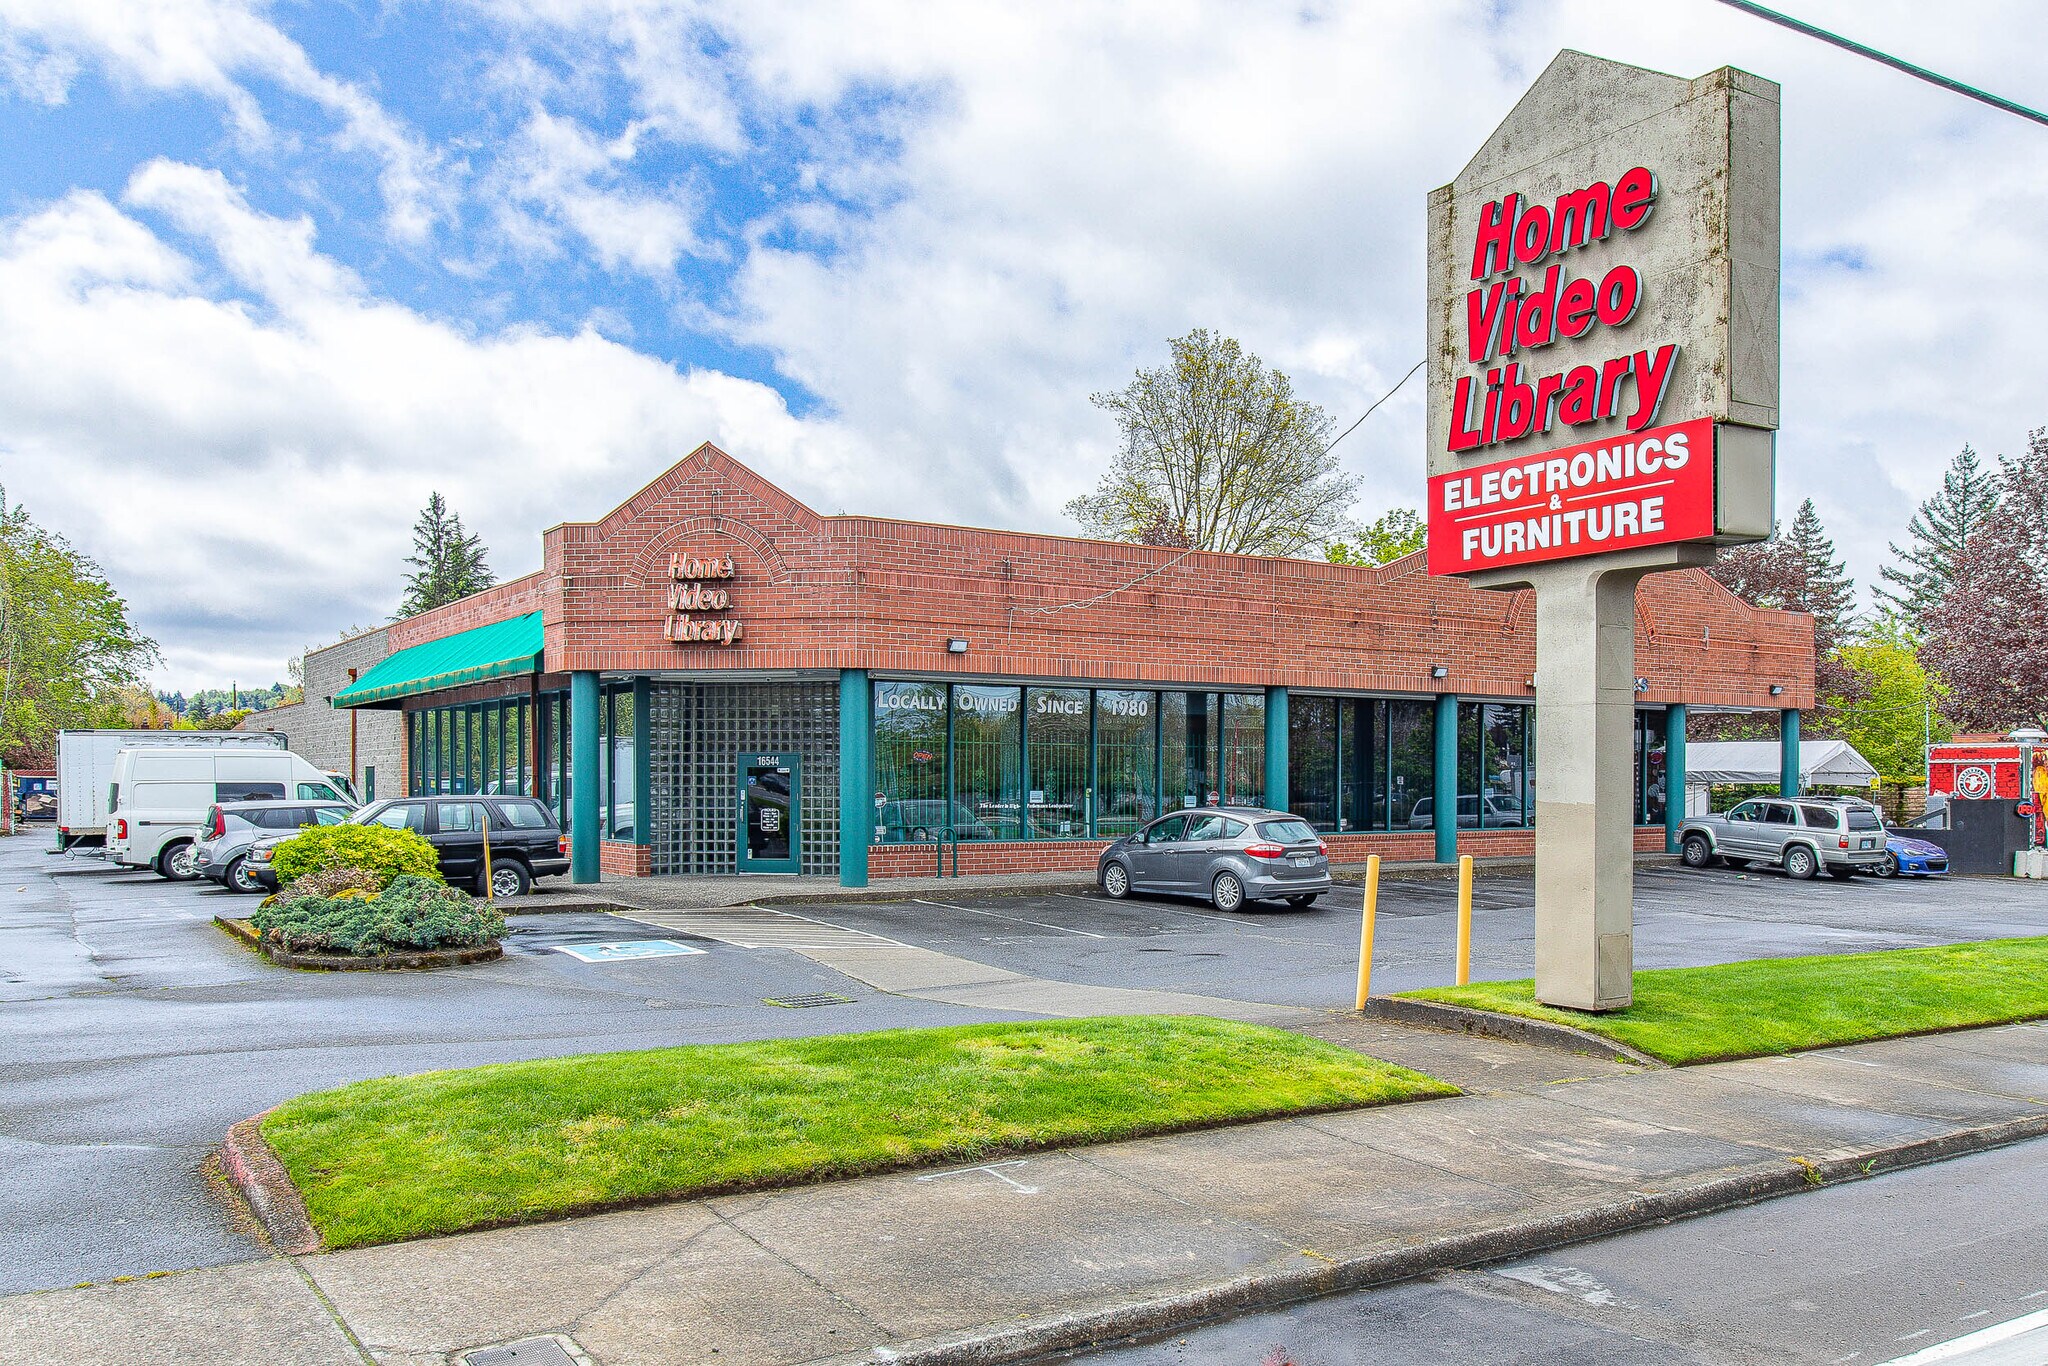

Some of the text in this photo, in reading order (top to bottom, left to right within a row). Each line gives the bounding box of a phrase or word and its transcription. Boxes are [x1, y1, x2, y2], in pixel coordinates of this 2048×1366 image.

[1471, 166, 1659, 281] Home
[1467, 264, 1642, 364] Video
[1447, 344, 1681, 452] Library
[1443, 432, 1690, 512] ELECTRONICS
[1549, 493, 1563, 510] &
[1462, 496, 1666, 561] FURNITURE
[668, 552, 734, 579] Home
[667, 583, 727, 610] Video
[664, 614, 739, 646] Library
[878, 690, 1148, 717] LOCALLY OWNED SINCE 1980
[757, 756, 779, 766] 16544
